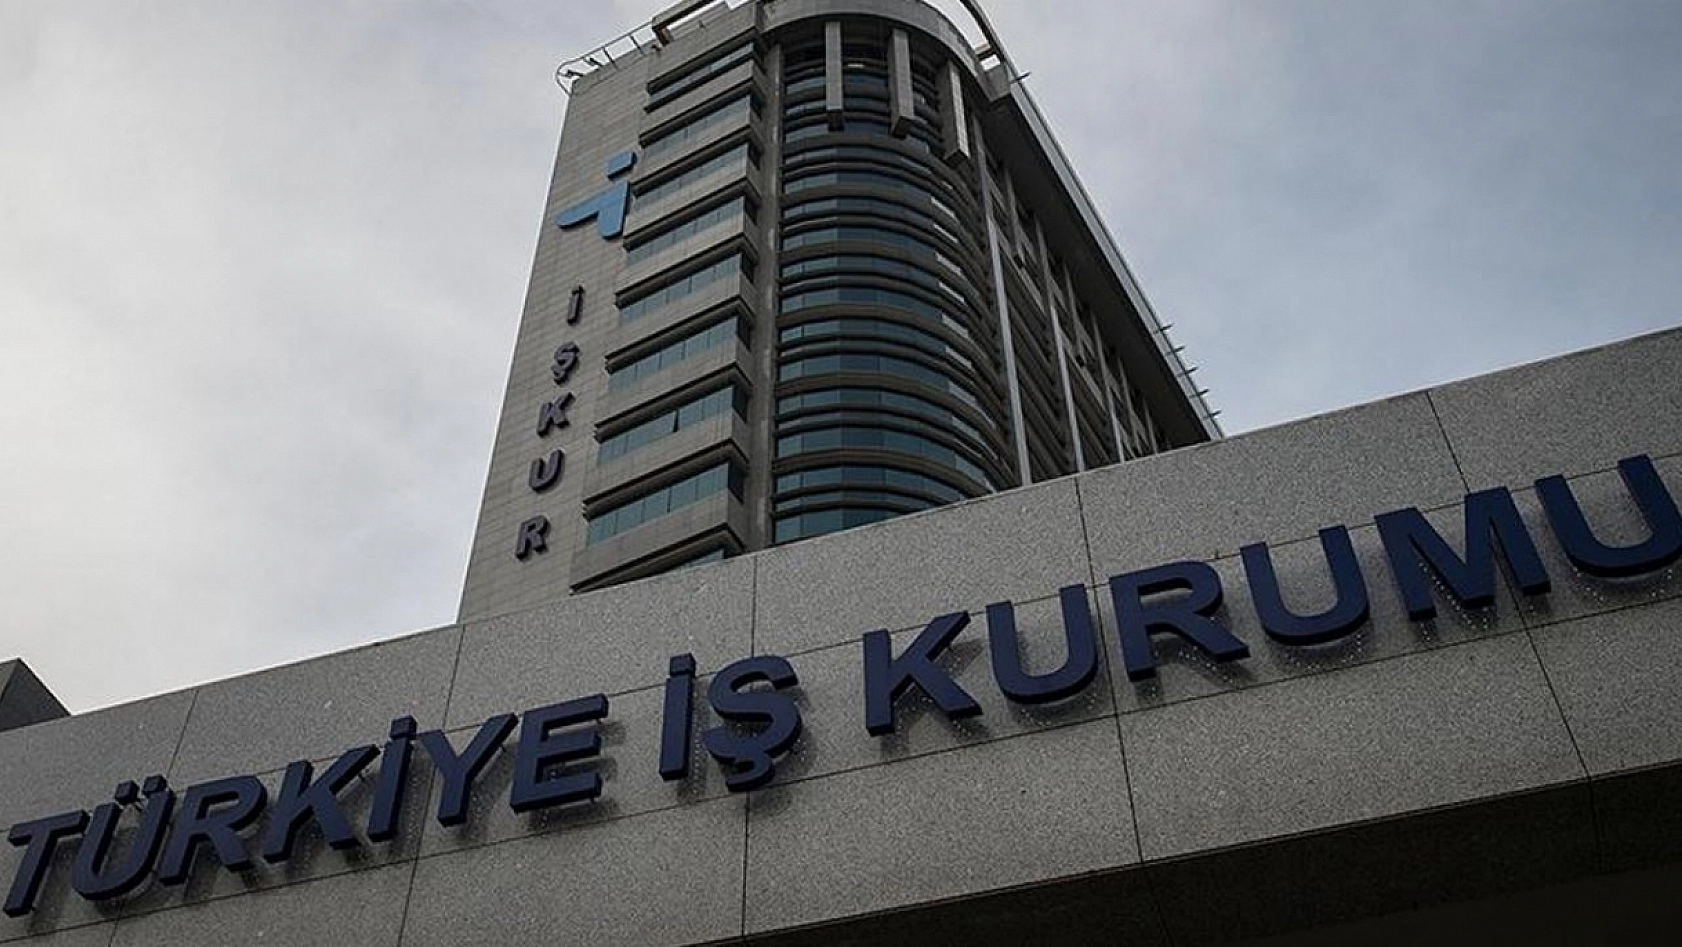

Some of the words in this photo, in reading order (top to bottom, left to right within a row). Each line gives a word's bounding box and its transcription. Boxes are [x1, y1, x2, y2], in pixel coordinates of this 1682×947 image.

[515, 285, 584, 560] İŞKUR
[2, 693, 609, 917] TÜRKİYE
[659, 653, 802, 792] İŞ
[862, 453, 1682, 736] KURUMU
